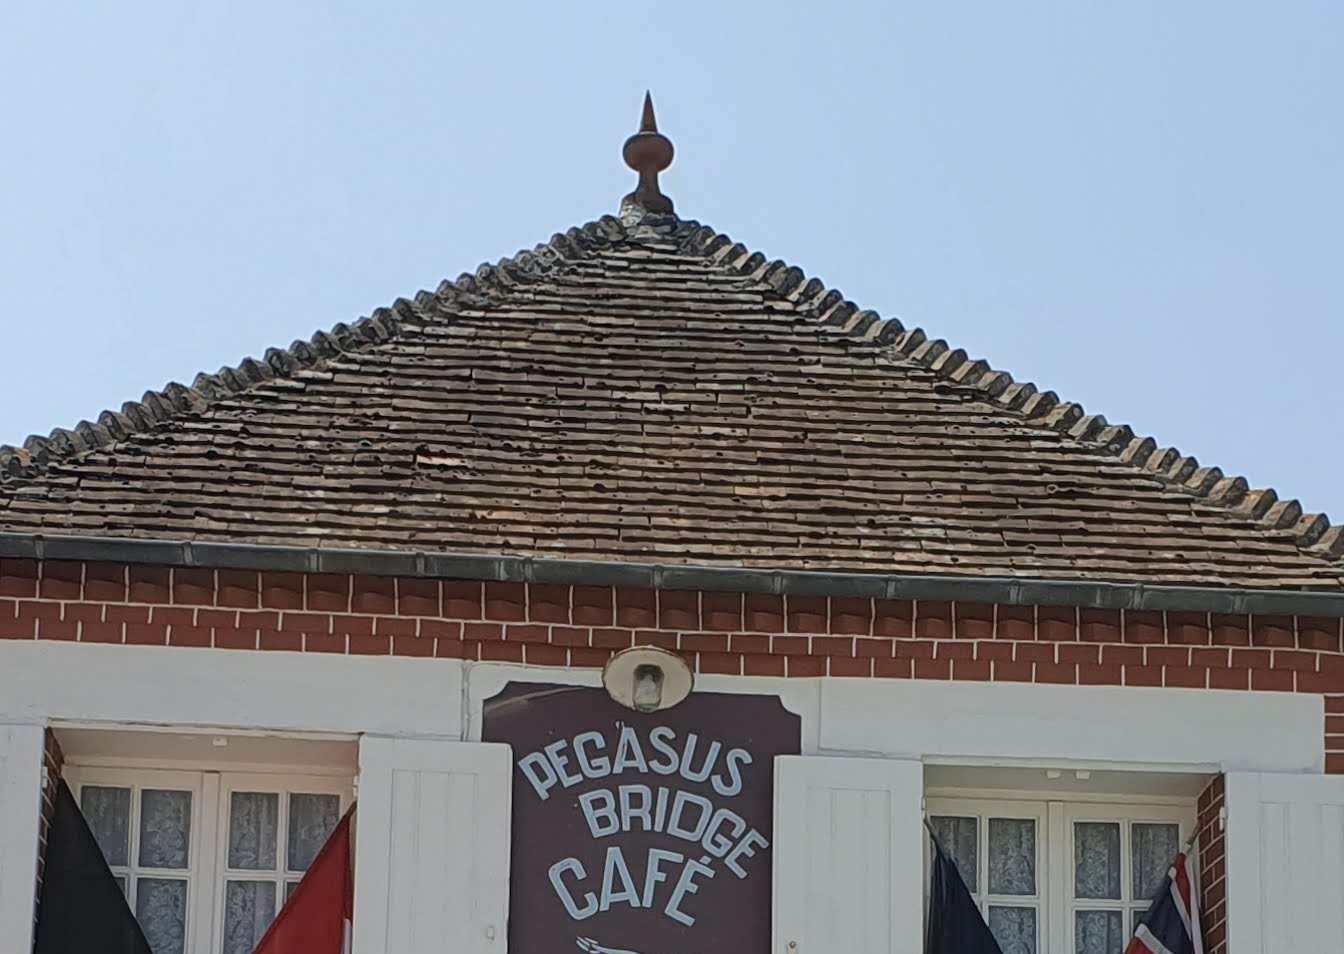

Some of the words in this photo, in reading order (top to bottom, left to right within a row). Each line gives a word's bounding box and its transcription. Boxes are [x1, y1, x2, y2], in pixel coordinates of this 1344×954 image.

[518, 726, 753, 800] PEGASUS
[578, 784, 769, 879] BRIDGE
[548, 846, 715, 926] CAFÉ
